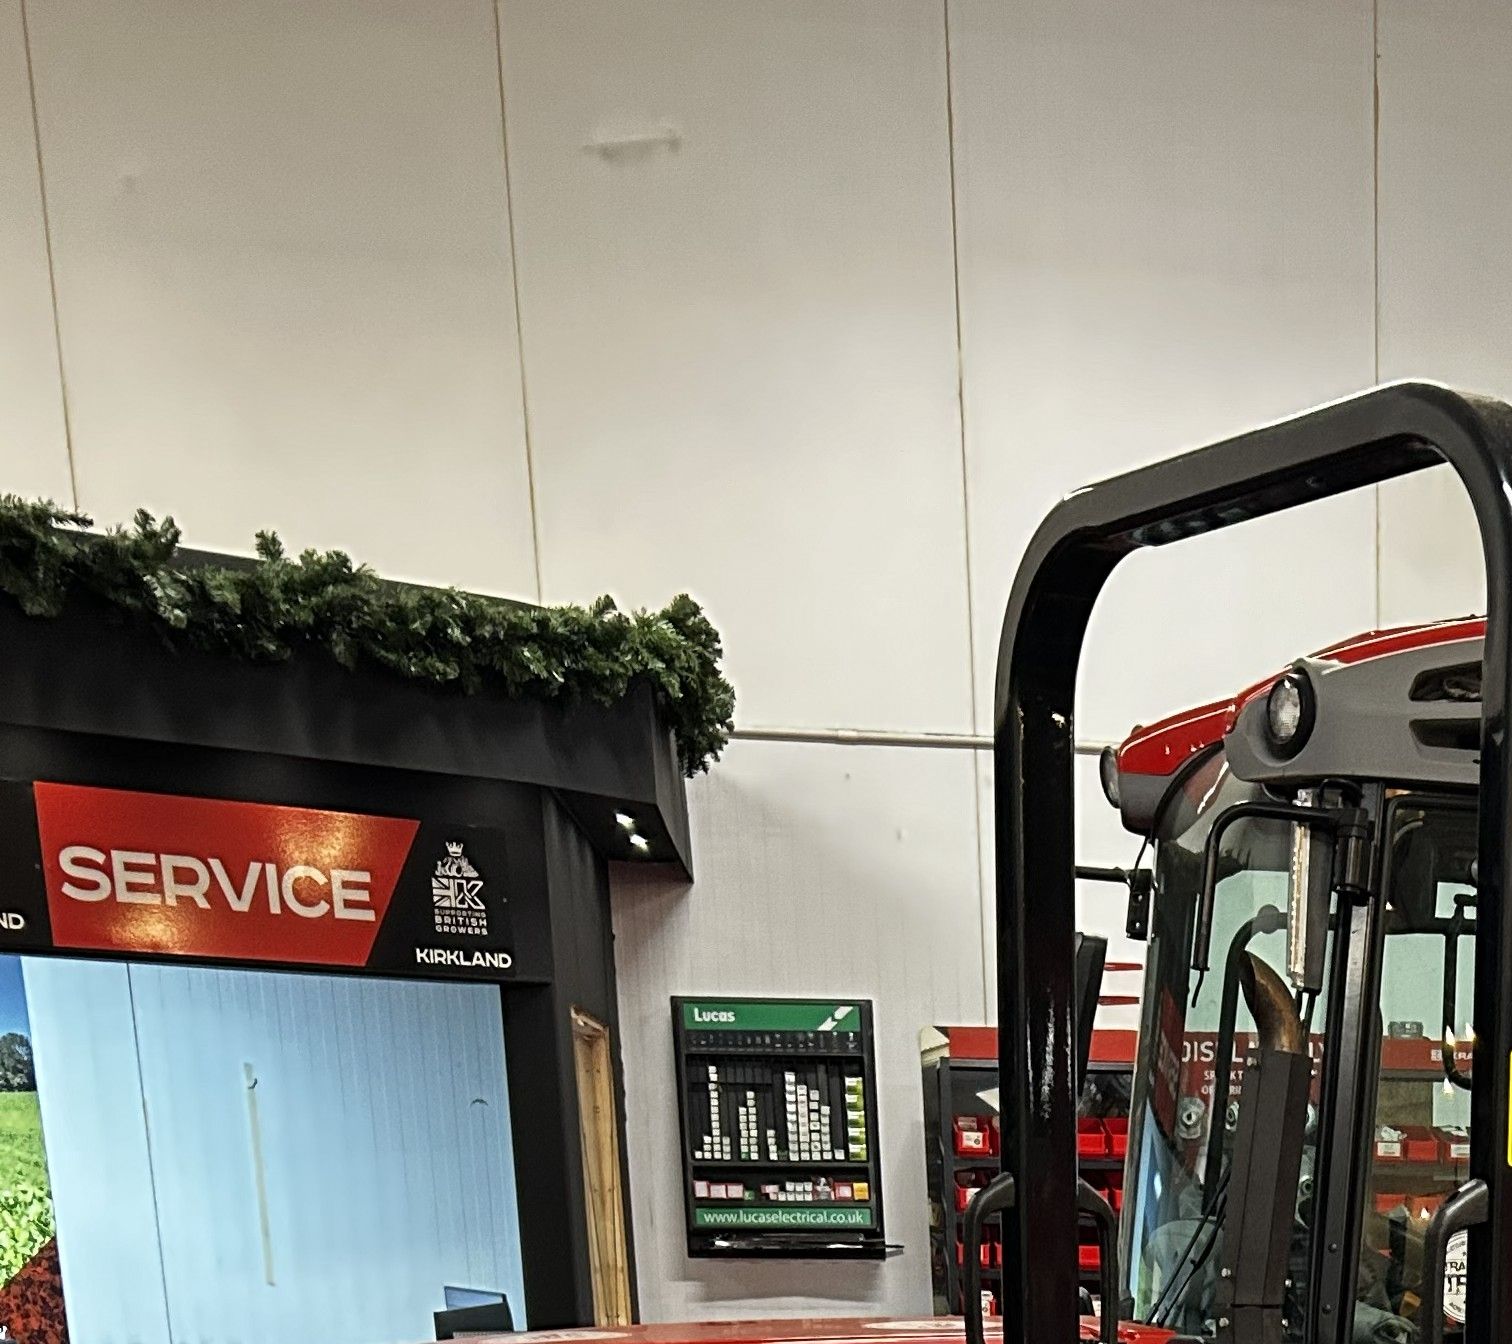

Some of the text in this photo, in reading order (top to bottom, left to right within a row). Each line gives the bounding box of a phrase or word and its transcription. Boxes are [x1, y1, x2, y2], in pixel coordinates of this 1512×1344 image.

[58, 845, 376, 922] SERVICE
[434, 908, 487, 918] SUPPORTING
[434, 915, 488, 927] BRITISH
[435, 924, 488, 935] GROWERS
[415, 947, 512, 969] KIRKLAND
[693, 1006, 736, 1023] Lucas
[703, 1209, 864, 1225] www.lucaselectrical.co.uk
